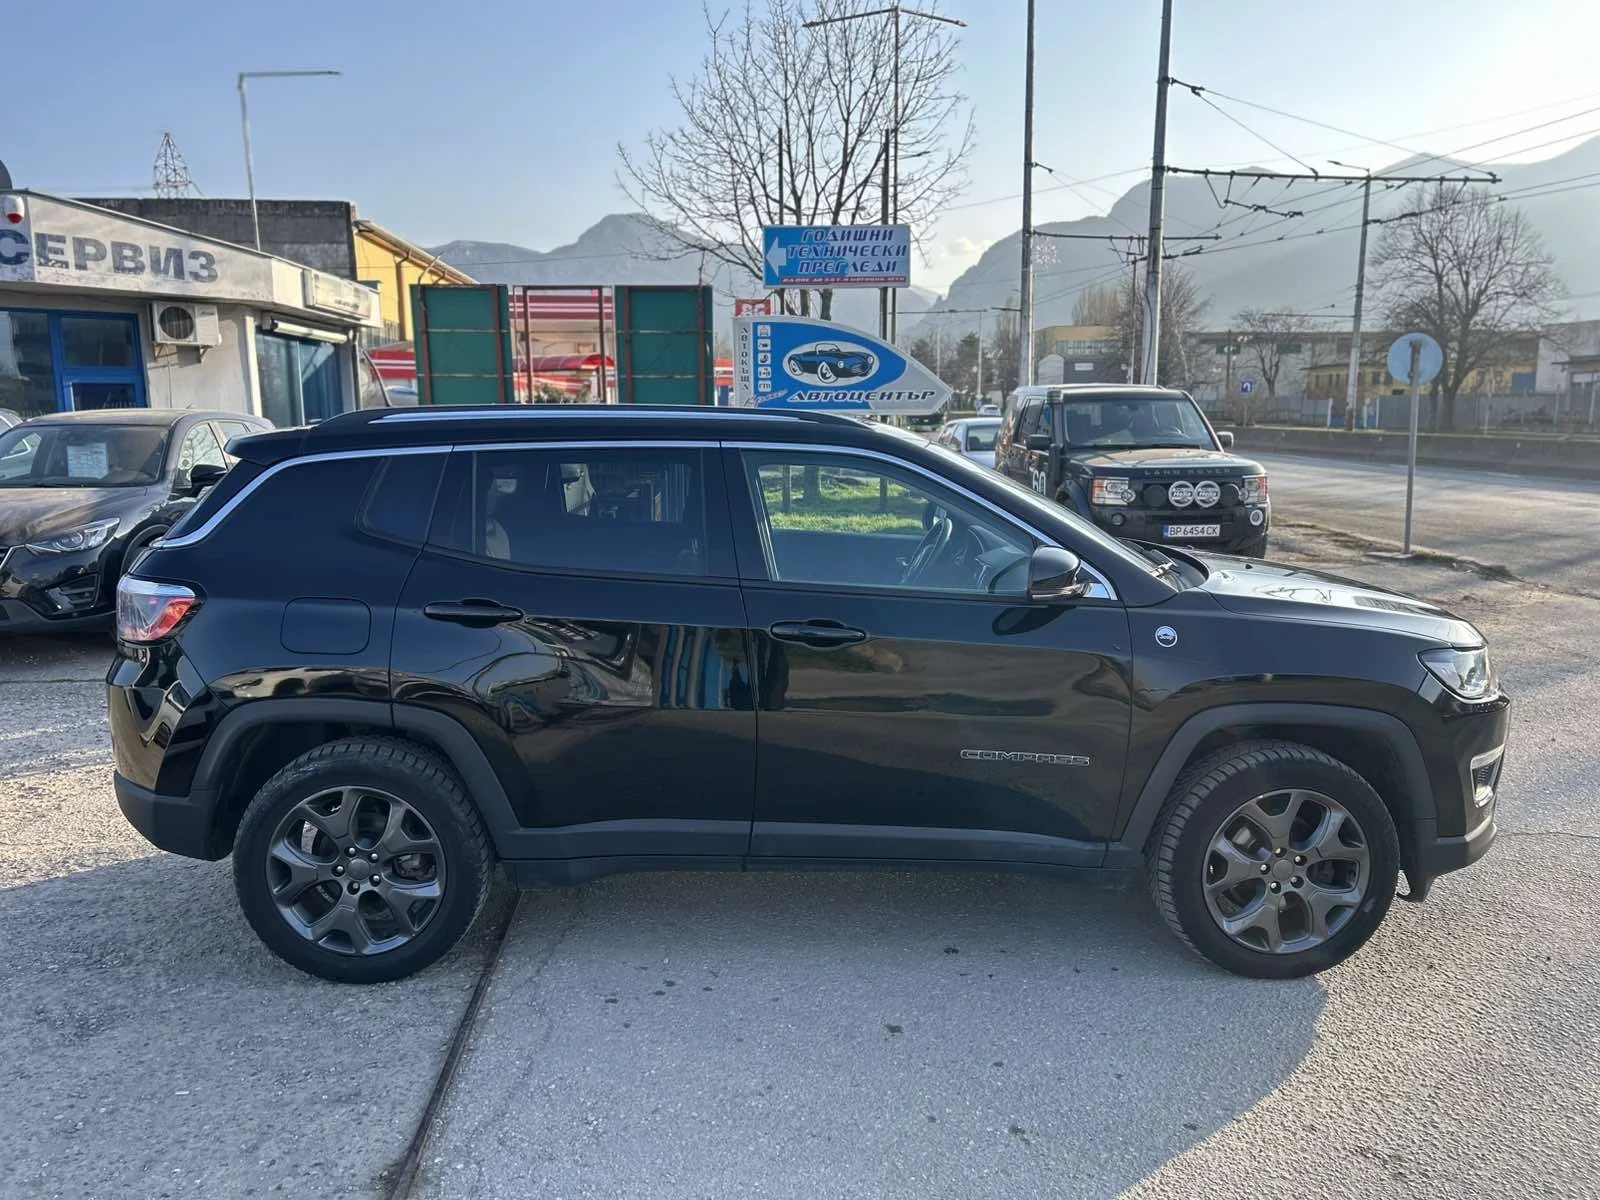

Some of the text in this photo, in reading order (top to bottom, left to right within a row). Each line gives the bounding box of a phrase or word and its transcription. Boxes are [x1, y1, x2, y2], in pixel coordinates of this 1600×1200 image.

[802, 229, 894, 242] ГОДИШНИ
[0, 229, 218, 283] СЕРВИЗ
[788, 244, 907, 258] ТЕХНИЧЕСКИ
[799, 260, 897, 273] ПРЕГЛЕДИ
[960, 749, 1089, 766] COMPASS
